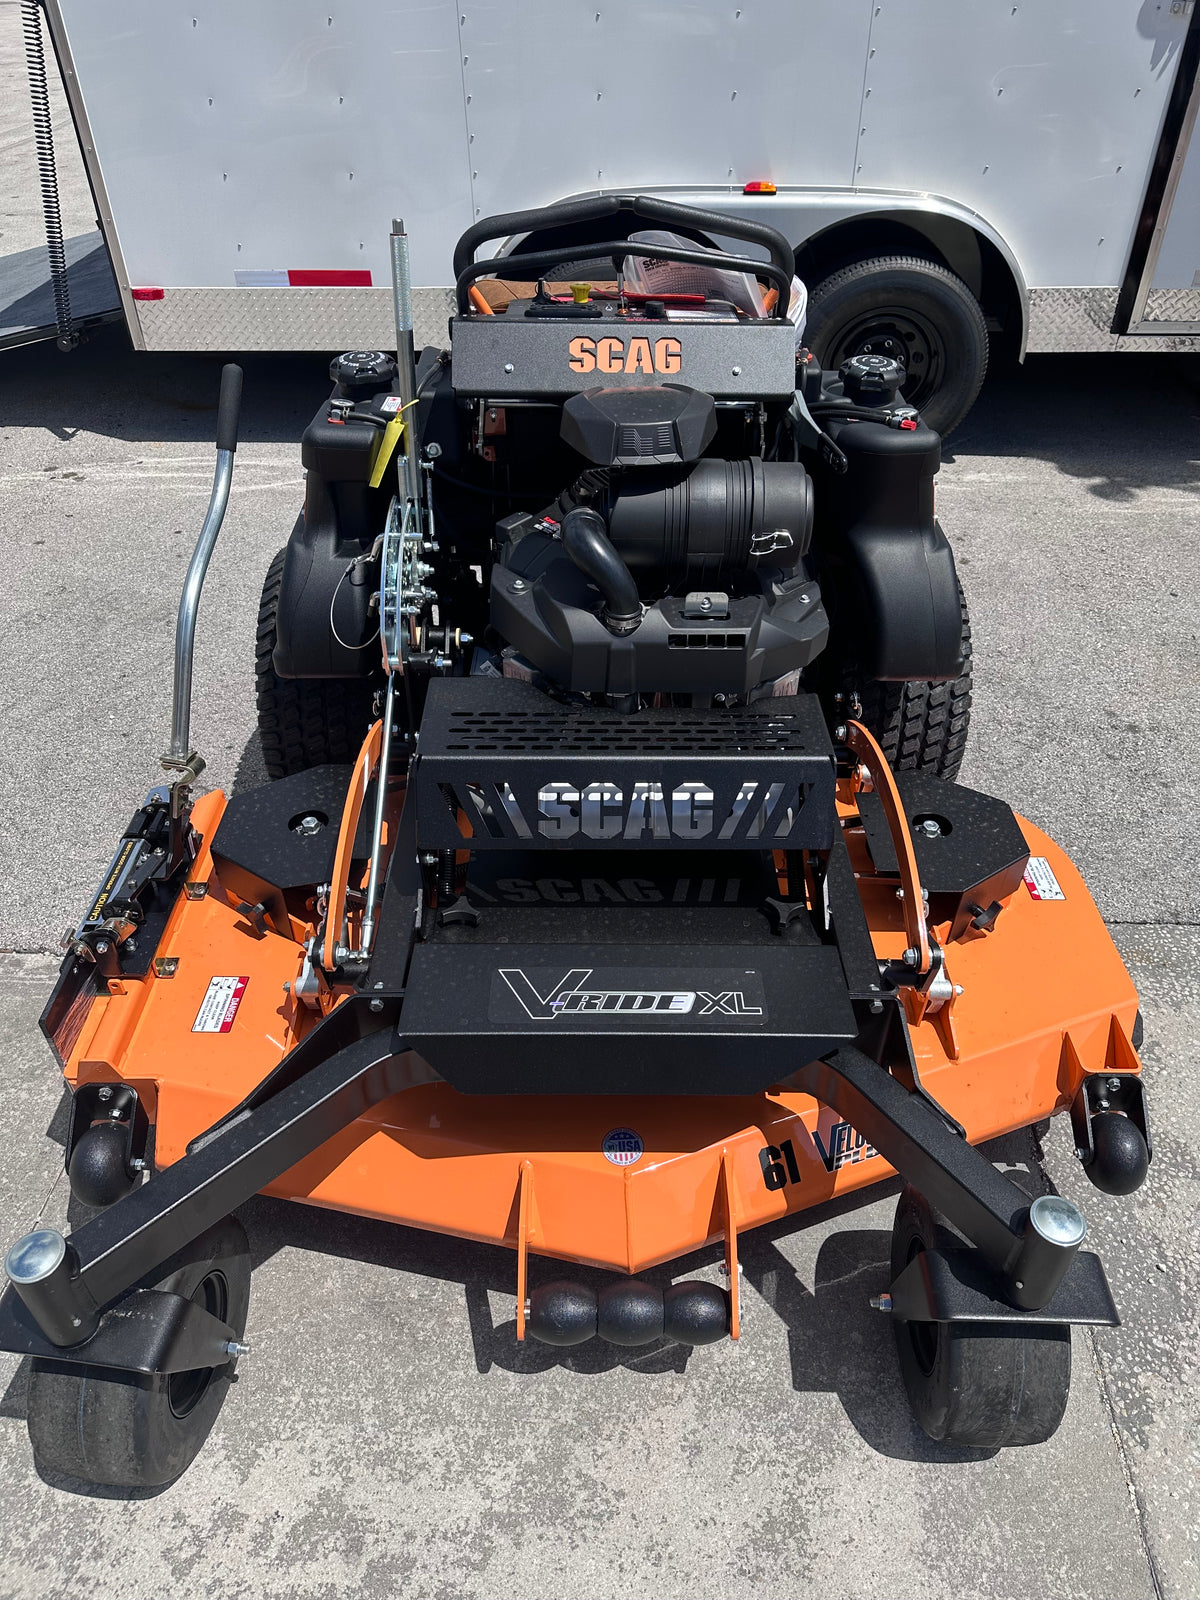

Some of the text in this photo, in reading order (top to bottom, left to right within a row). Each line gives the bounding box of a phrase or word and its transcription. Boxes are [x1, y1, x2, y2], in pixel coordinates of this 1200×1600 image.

[568, 336, 682, 374] SCAG
[537, 782, 714, 839] SCAG
[90, 893, 109, 921] CAUTION
[223, 997, 240, 1022] DANGER
[696, 991, 763, 1015] XL
[617, 1140, 641, 1152] USA
[758, 1139, 801, 1192] 61
